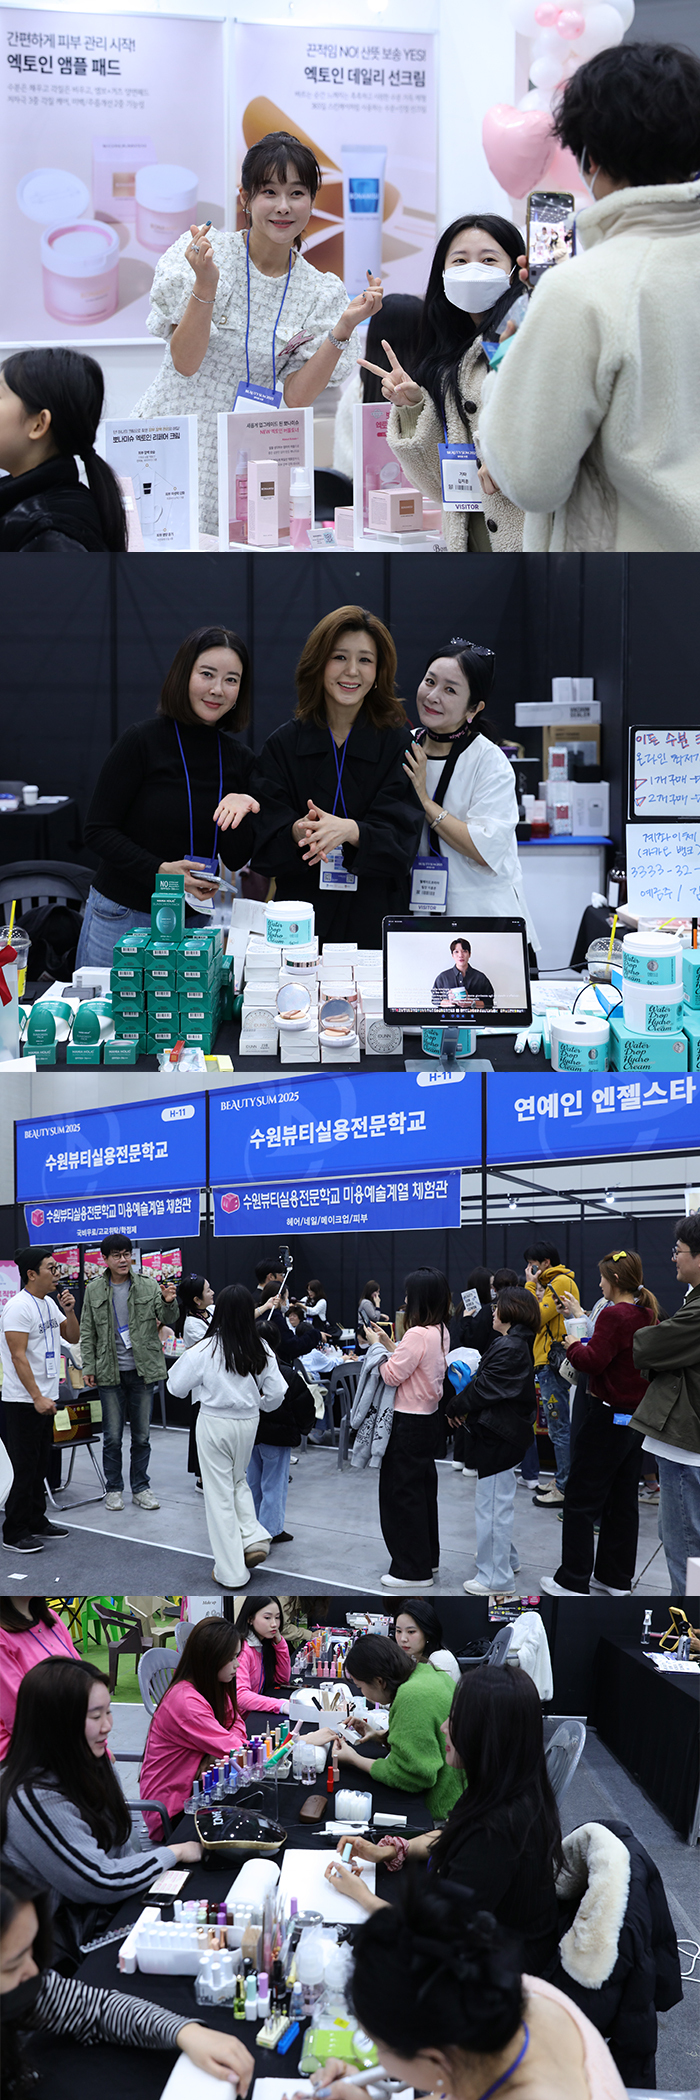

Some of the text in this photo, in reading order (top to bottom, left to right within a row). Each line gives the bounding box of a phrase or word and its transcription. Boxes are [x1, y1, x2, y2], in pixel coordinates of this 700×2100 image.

[7, 31, 136, 52] 간편하게 피부 관리 시작!
[306, 43, 427, 62] 끈적임 NO! 산뜻 보송 YES!
[7, 54, 121, 76] 엑토인 앰플 패드
[304, 66, 425, 87] 엑토인 데일리 선크림
[666, 731, 689, 750] 수분
[637, 751, 668, 767] 온라인
[160, 880, 169, 888] NO
[648, 1004, 671, 1013] Water
[648, 1011, 669, 1020] Drop
[647, 1024, 672, 1032] Cream
[648, 1018, 672, 1028] Hydro
[559, 1043, 582, 1054] Water
[624, 1040, 651, 1049] Water
[559, 1049, 579, 1059] Drop
[624, 1047, 647, 1057] Drop
[559, 1056, 582, 1066] Hydro
[623, 1055, 650, 1065] Hydro
[559, 1063, 583, 1072] Cream
[622, 1062, 652, 1071] Cream
[278, 1091, 300, 1103] 2025
[514, 1076, 697, 1122] 연예인 엔젤스타
[169, 1108, 187, 1118] H-11
[65, 1123, 81, 1134] 2025
[250, 1110, 427, 1150] 수원뷰티실용전문학교
[45, 1140, 169, 1172] 수원뷰티실용전문학교
[243, 1180, 449, 1211] 수원뷰티실용전문학교 미용예술계열 체험관
[46, 1197, 192, 1224] 수원뷰티실용전문학교 미용예술계열 체험관
[286, 1213, 369, 1227] 헤어/네일/메이크업/피부
